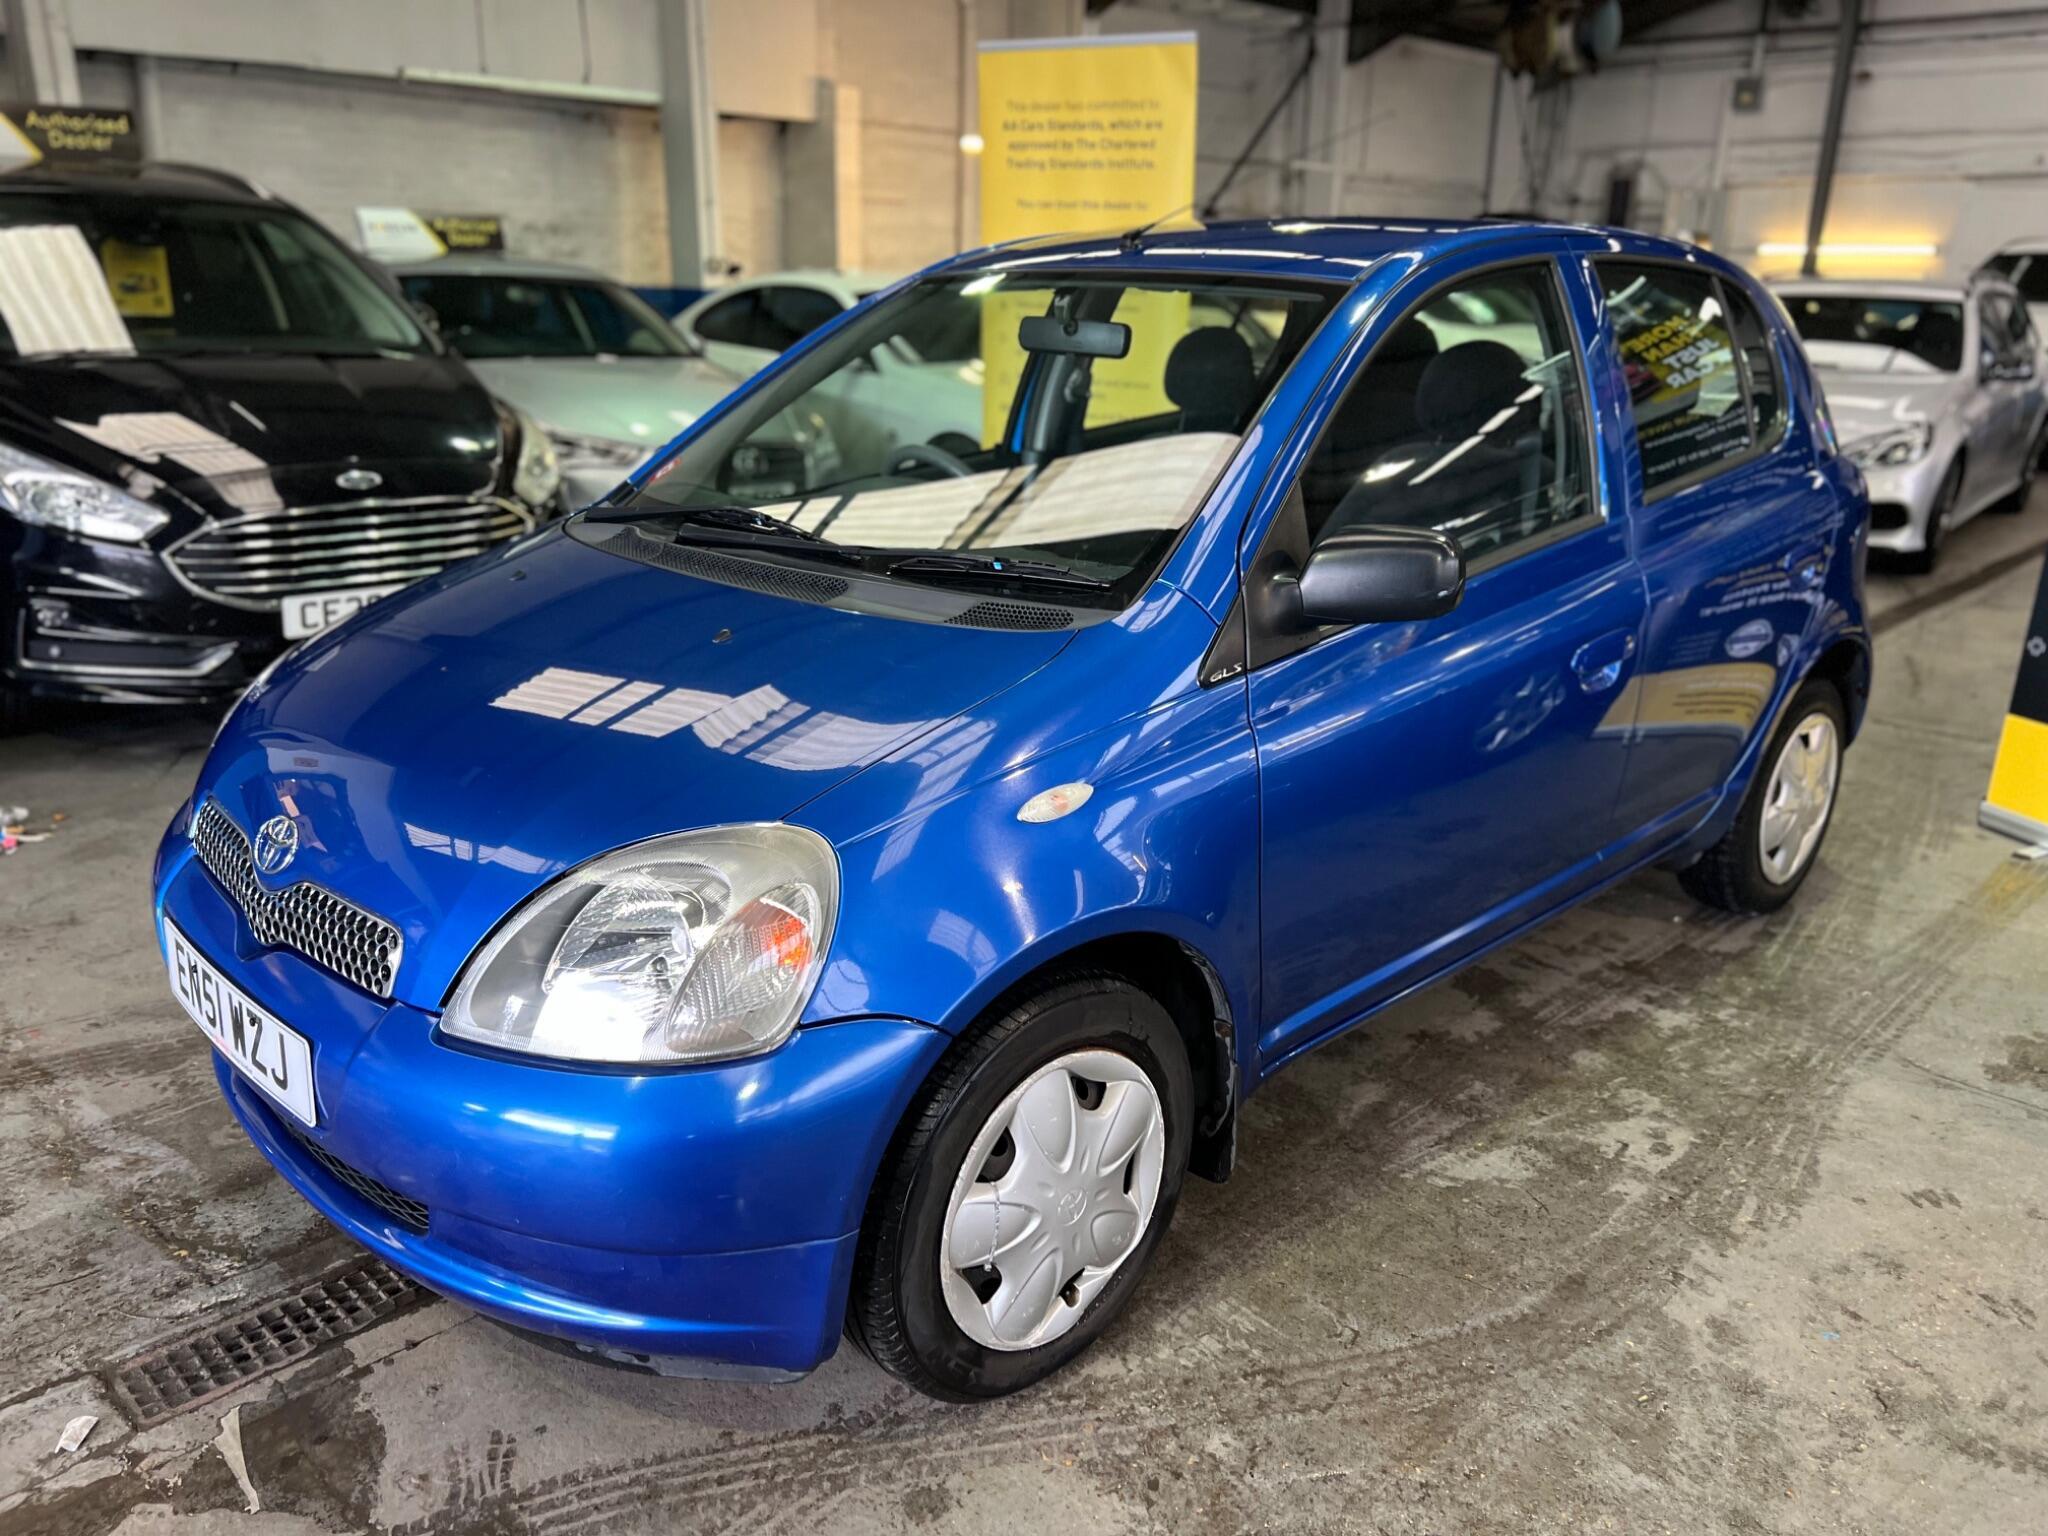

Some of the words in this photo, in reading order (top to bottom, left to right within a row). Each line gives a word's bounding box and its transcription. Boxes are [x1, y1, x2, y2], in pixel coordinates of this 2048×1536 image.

[48, 129, 113, 150] Dealer
[1209, 662, 1242, 682] GLS
[174, 937, 224, 1037] EN51
[227, 991, 288, 1090] WZJ
